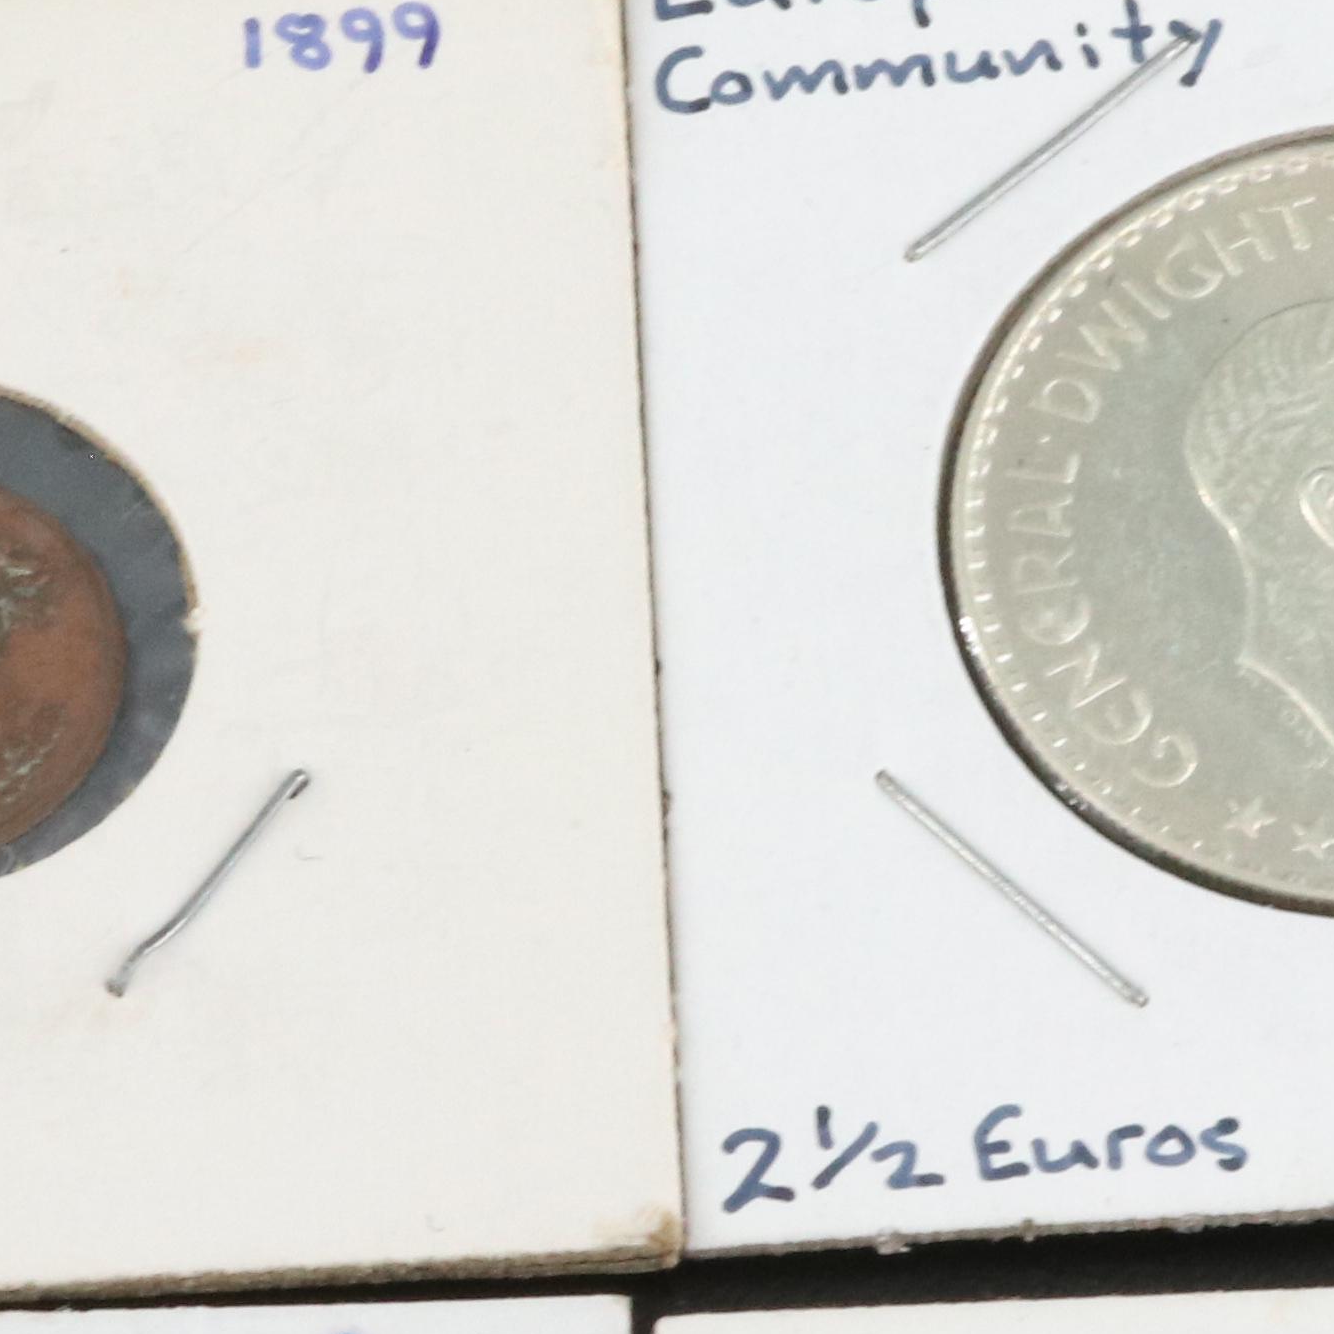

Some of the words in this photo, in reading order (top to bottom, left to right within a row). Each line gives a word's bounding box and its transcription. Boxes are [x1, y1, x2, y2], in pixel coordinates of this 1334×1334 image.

[245, 3, 440, 73] 1899
[654, 3, 1222, 116] Community
[1030, 195, 1317, 423] DWIGHT
[1007, 453, 1199, 789] GENERAL
[974, 1104, 1247, 1181] Euros
